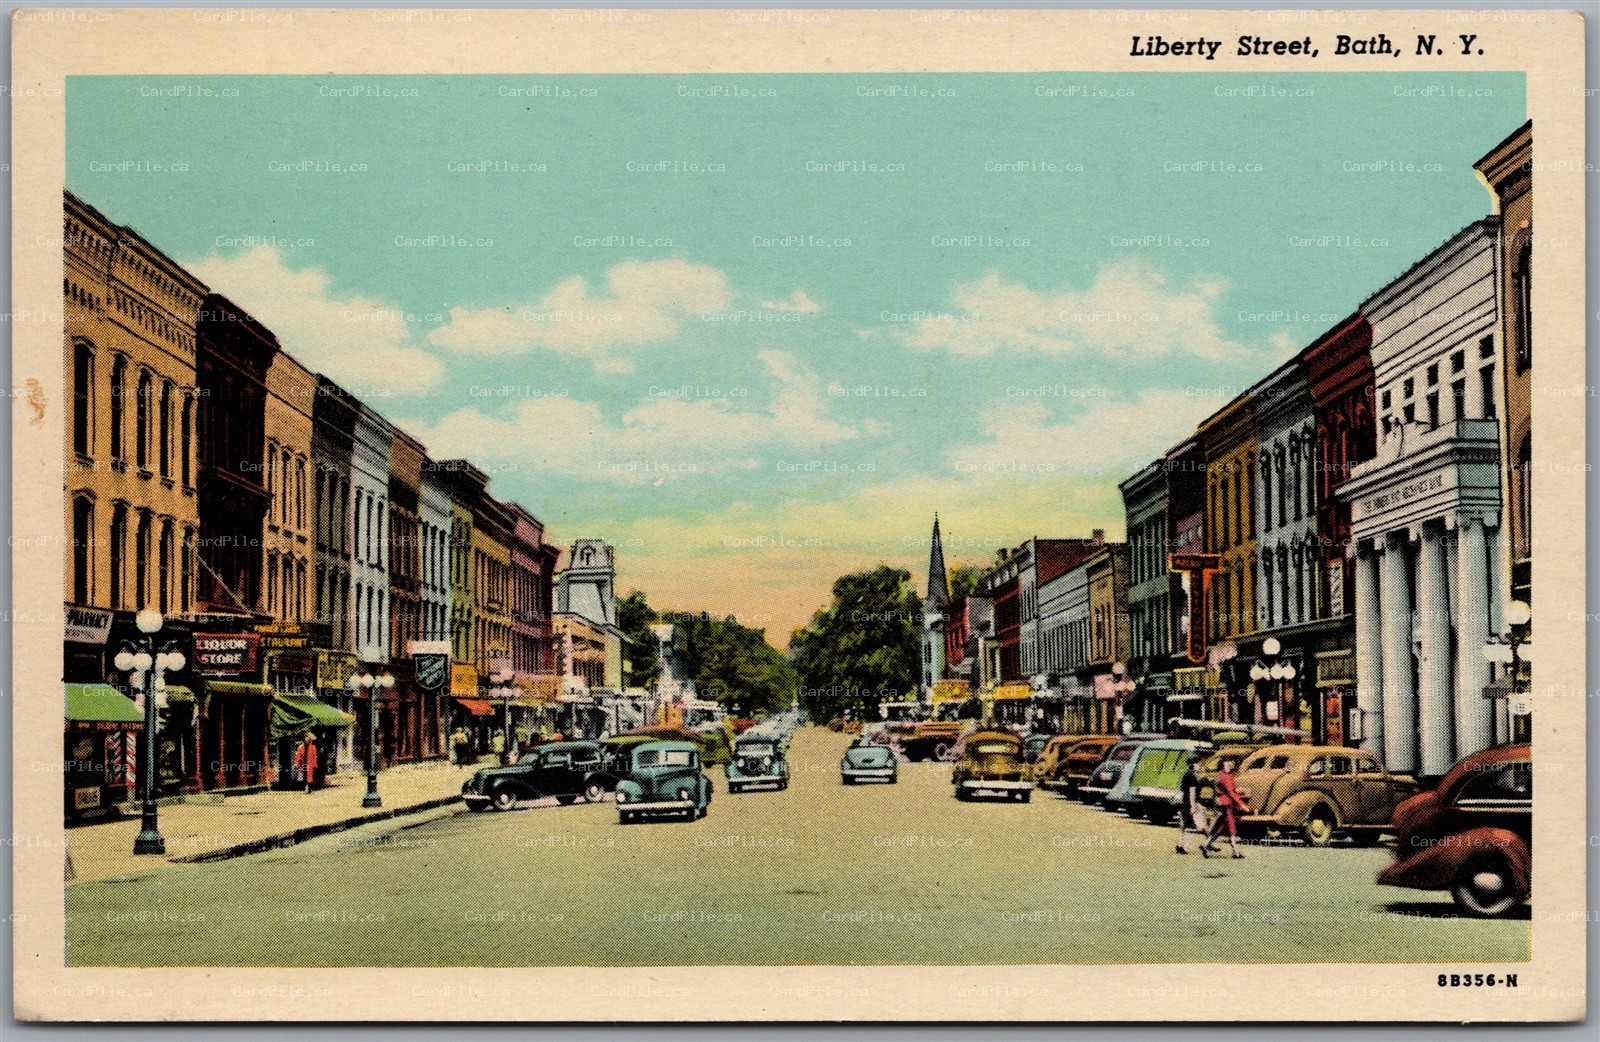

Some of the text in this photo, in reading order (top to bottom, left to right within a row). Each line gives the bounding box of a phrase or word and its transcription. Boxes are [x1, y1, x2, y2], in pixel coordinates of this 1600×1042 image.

[67, 609, 108, 629] PHARMACY
[196, 639, 247, 650] LIQUOR
[199, 653, 242, 664] STORE
[1438, 974, 1517, 987] 8B356-N
